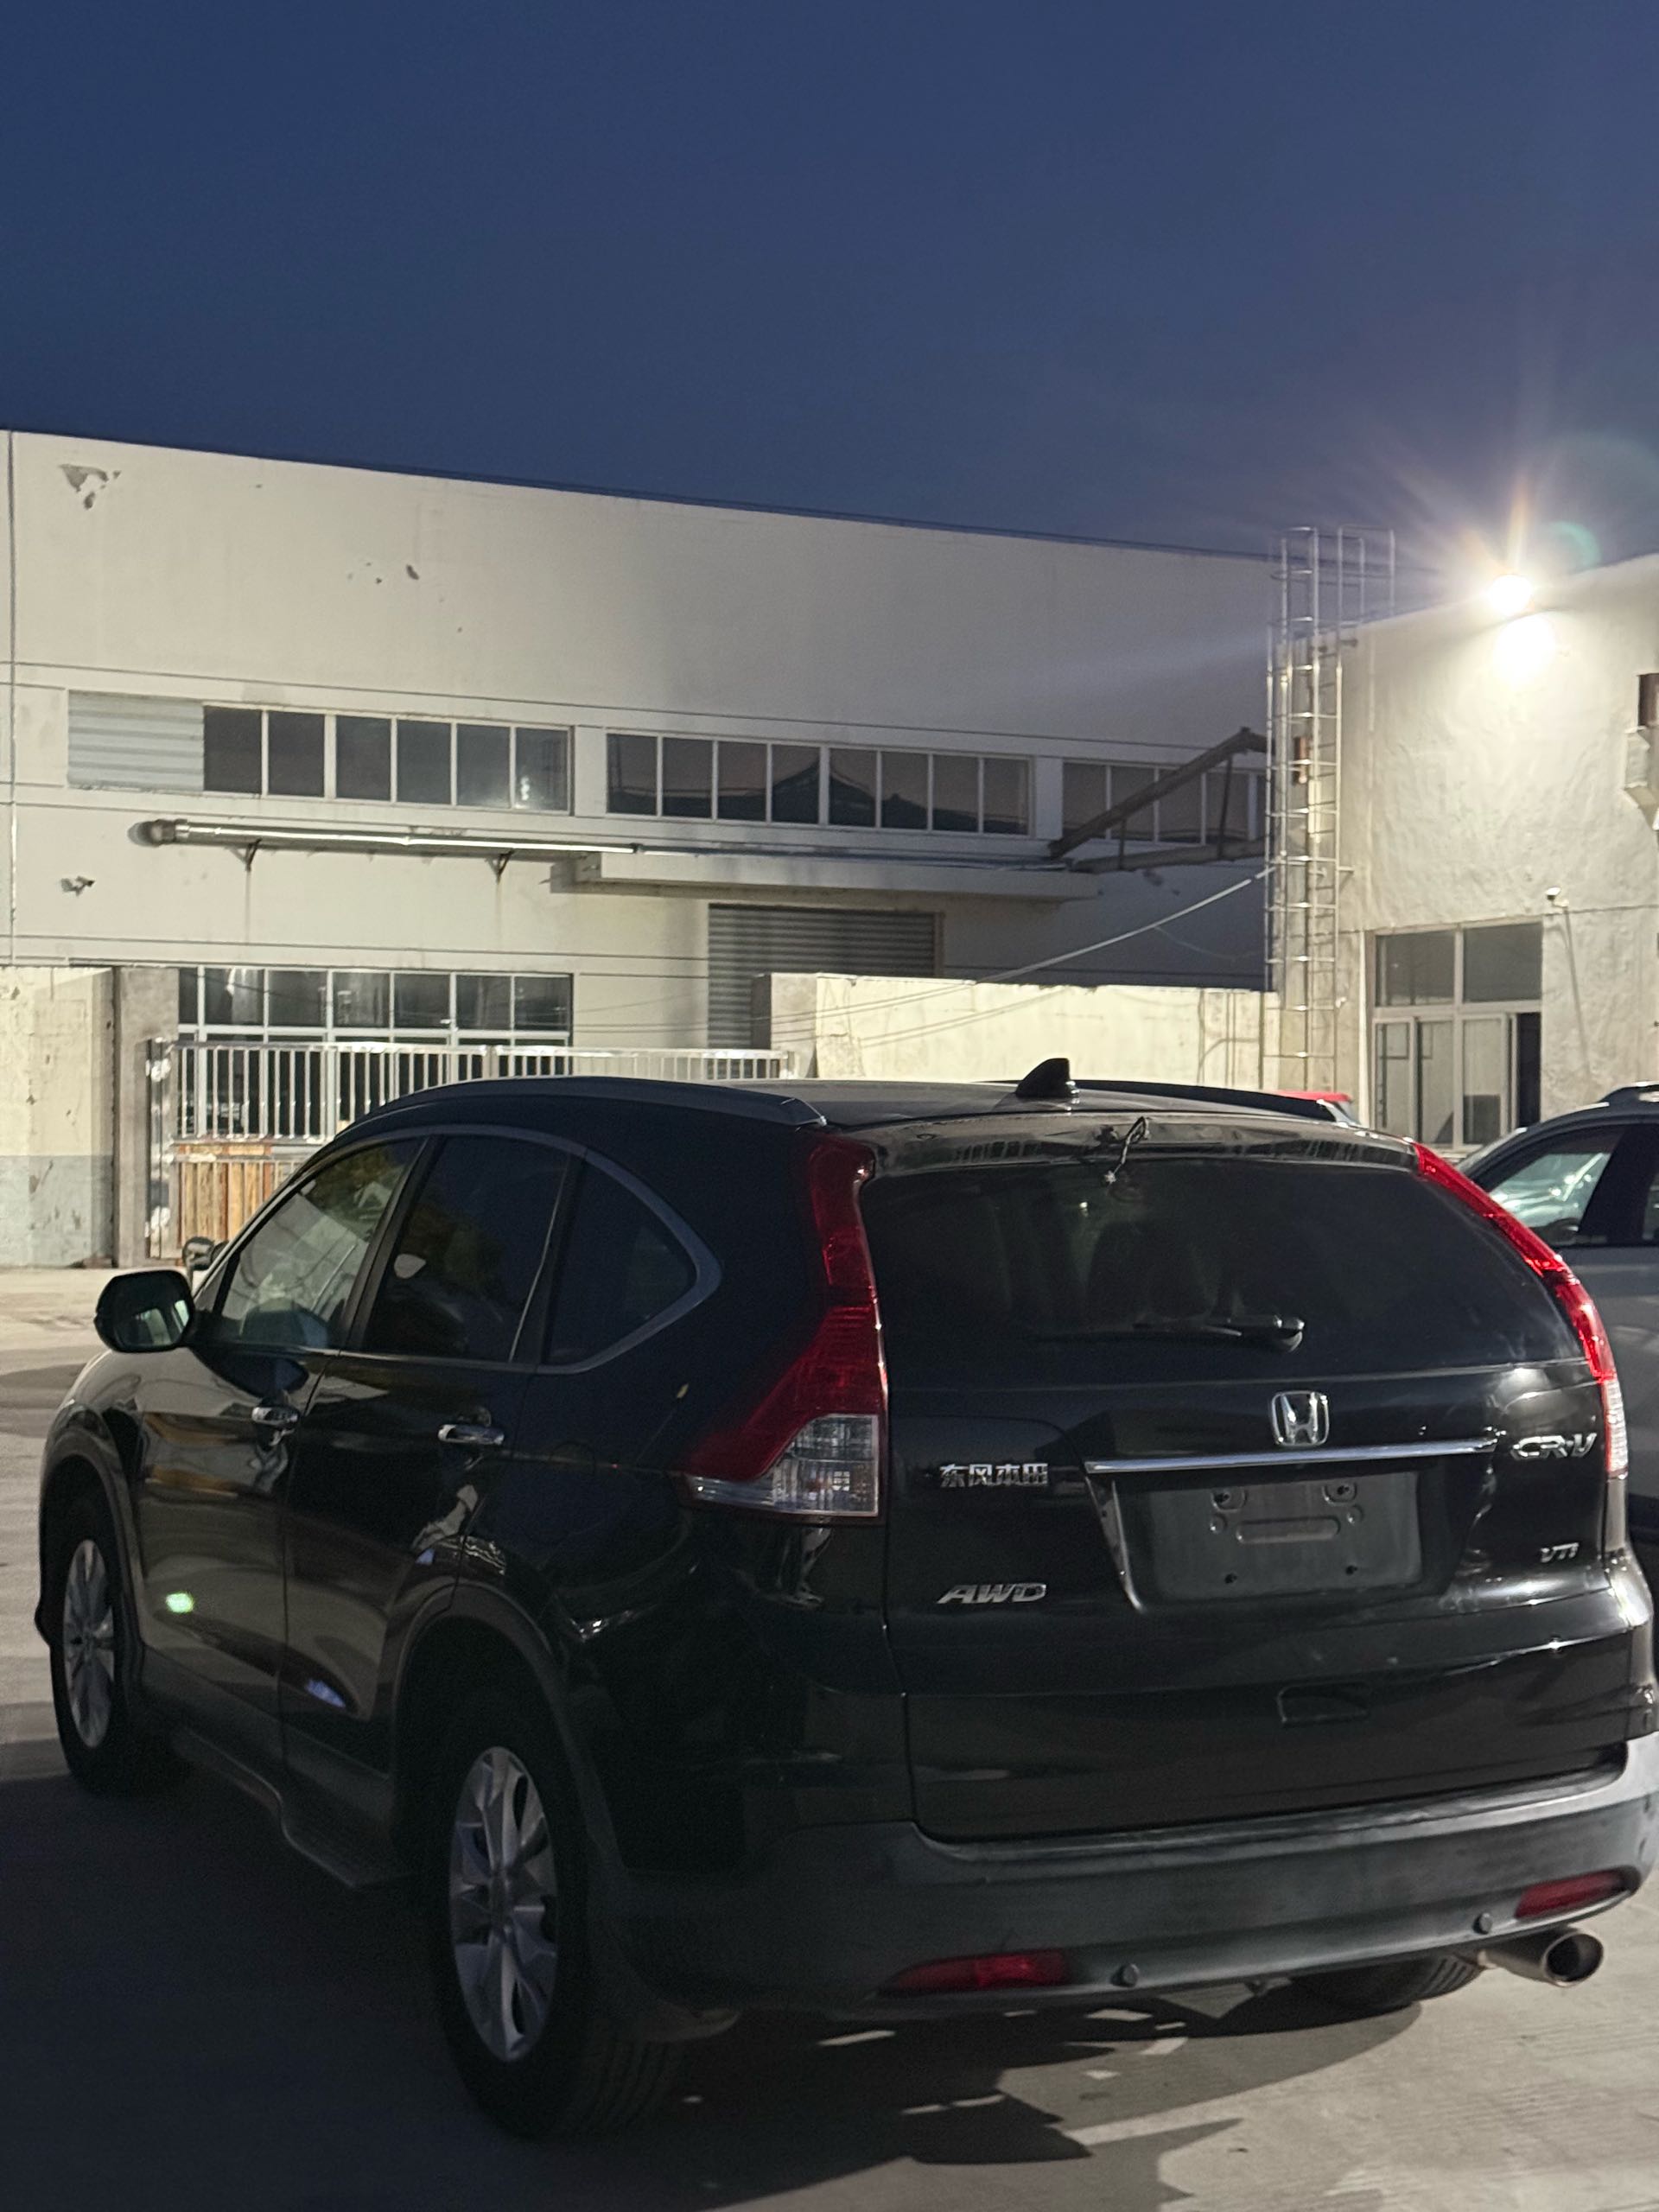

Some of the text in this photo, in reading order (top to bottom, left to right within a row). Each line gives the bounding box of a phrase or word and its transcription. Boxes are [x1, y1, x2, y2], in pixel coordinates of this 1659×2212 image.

[939, 1462, 1049, 1488] 东风本田
[937, 1582, 1047, 1605] AWD
